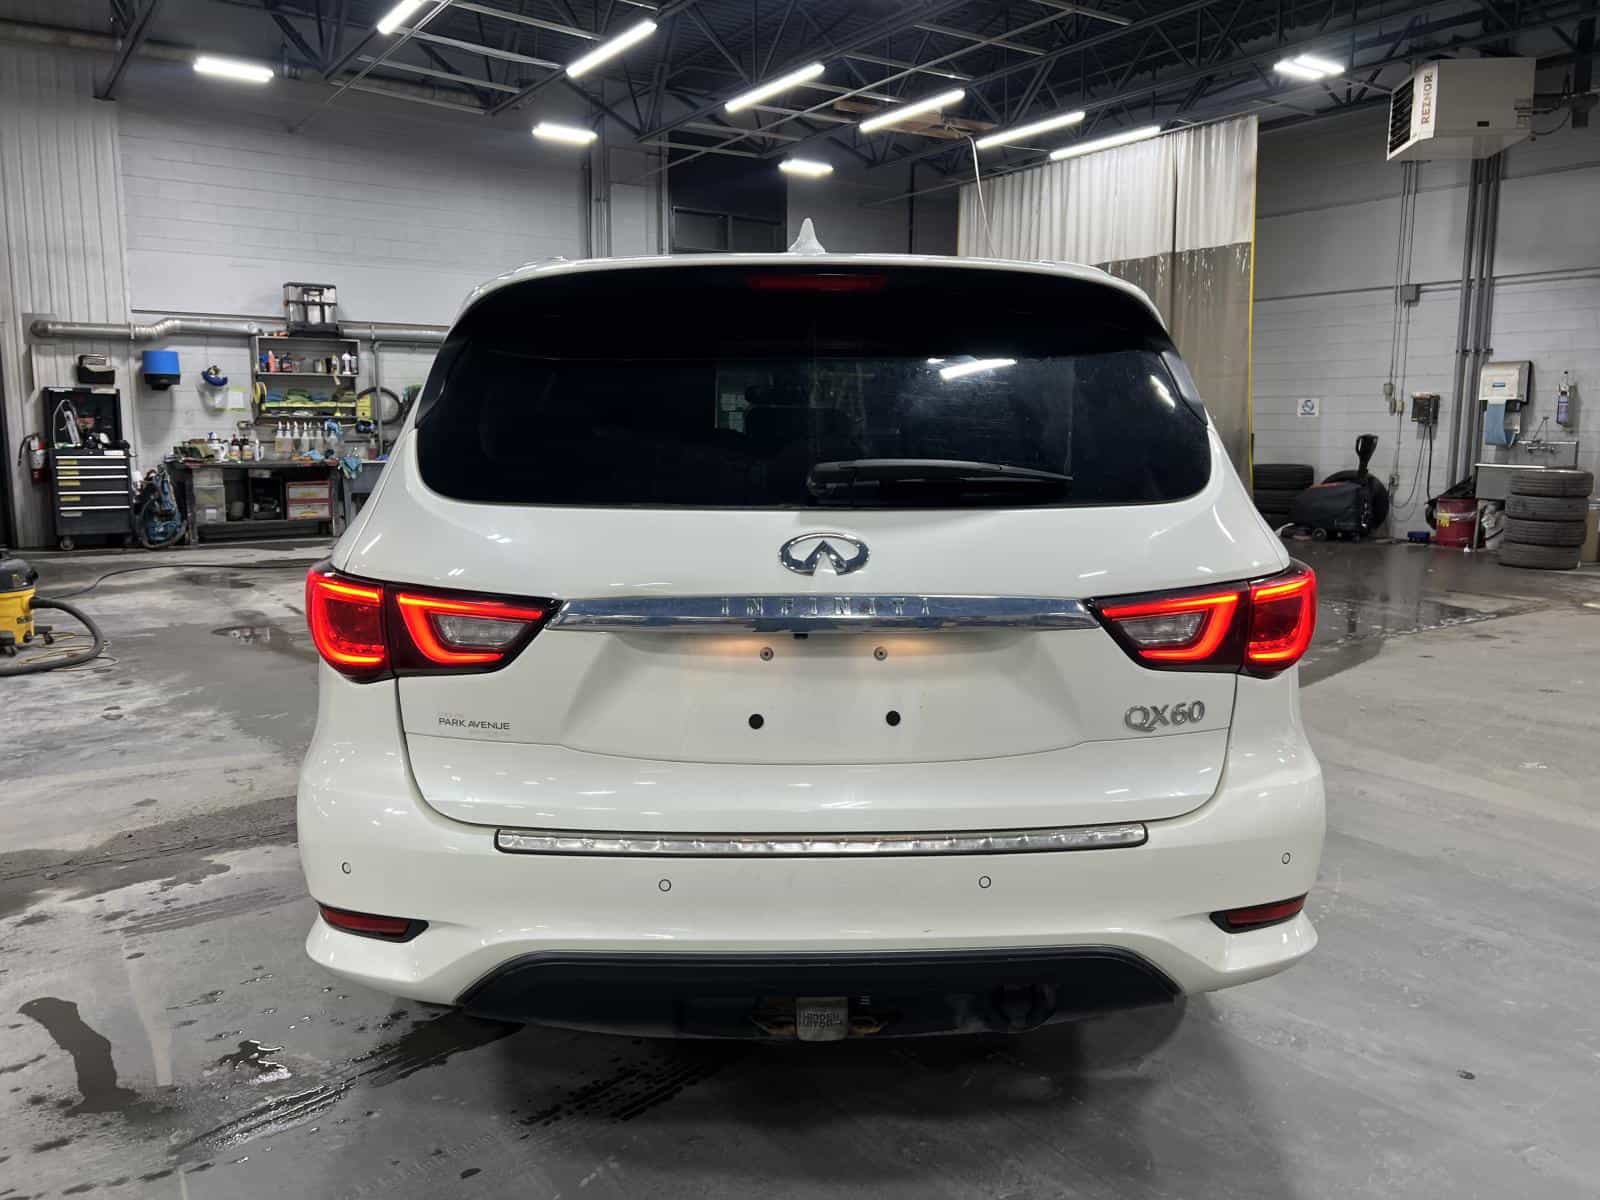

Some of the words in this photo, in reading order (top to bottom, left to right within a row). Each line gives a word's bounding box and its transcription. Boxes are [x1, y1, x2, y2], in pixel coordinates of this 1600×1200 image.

[1421, 71, 1433, 124] REZNOR
[720, 597, 931, 617] INFINITI
[438, 717, 466, 728] PARK
[467, 720, 511, 730] AVENUE
[1124, 700, 1205, 732] QX60
